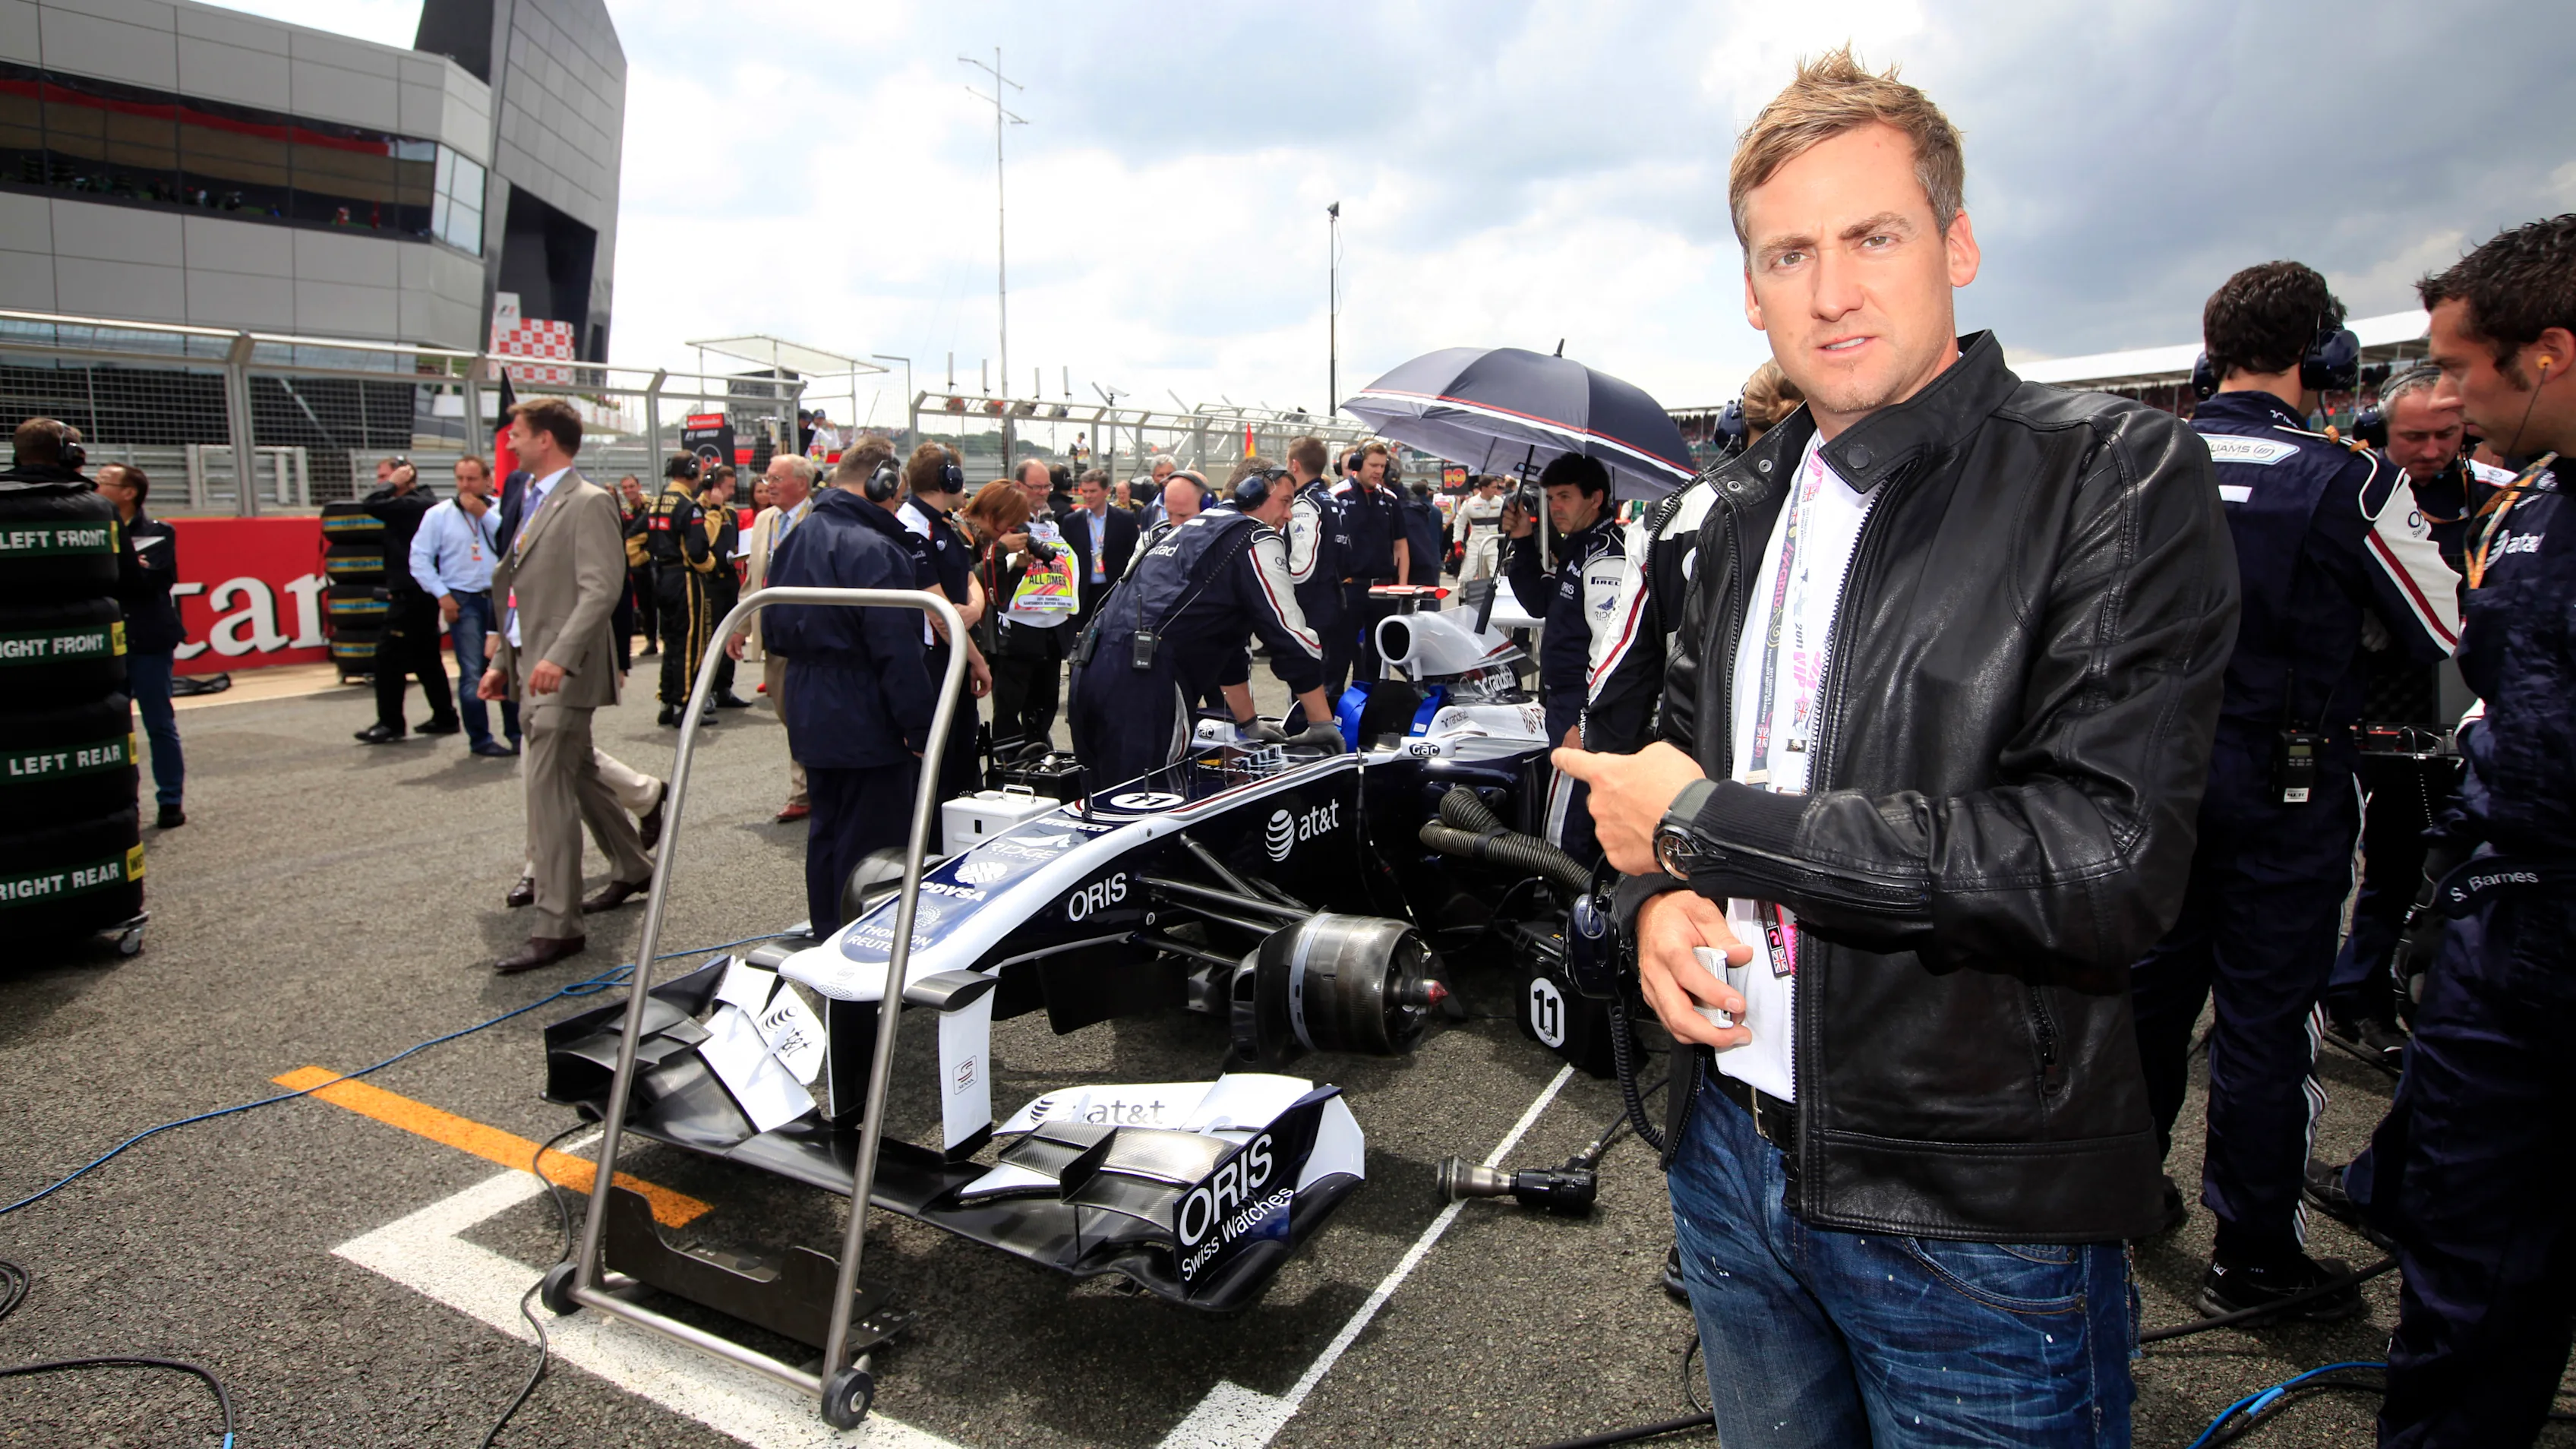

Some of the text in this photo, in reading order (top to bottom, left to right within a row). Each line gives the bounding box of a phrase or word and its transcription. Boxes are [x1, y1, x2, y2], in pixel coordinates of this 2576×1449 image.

[2210, 444, 2251, 453] LIAMS
[0, 529, 106, 550] LEFT FRONT
[1028, 575, 1066, 586] ALL TIMES
[0, 639, 47, 658] IGHT
[52, 633, 104, 655] FRONT
[9, 743, 122, 776] LEFT REAR
[1299, 798, 1340, 841] at&t
[0, 862, 120, 901] RIGHT REAR
[919, 880, 988, 902] PDVSA
[2468, 870, 2540, 892] Barnes
[1068, 872, 1128, 921] ORIS
[859, 923, 933, 947] THOMON
[1533, 988, 1558, 1039] 11
[1087, 1100, 1166, 1125] at&t
[1179, 1133, 1274, 1246] ORIS
[1181, 1186, 1294, 1282] Swiss Watches
